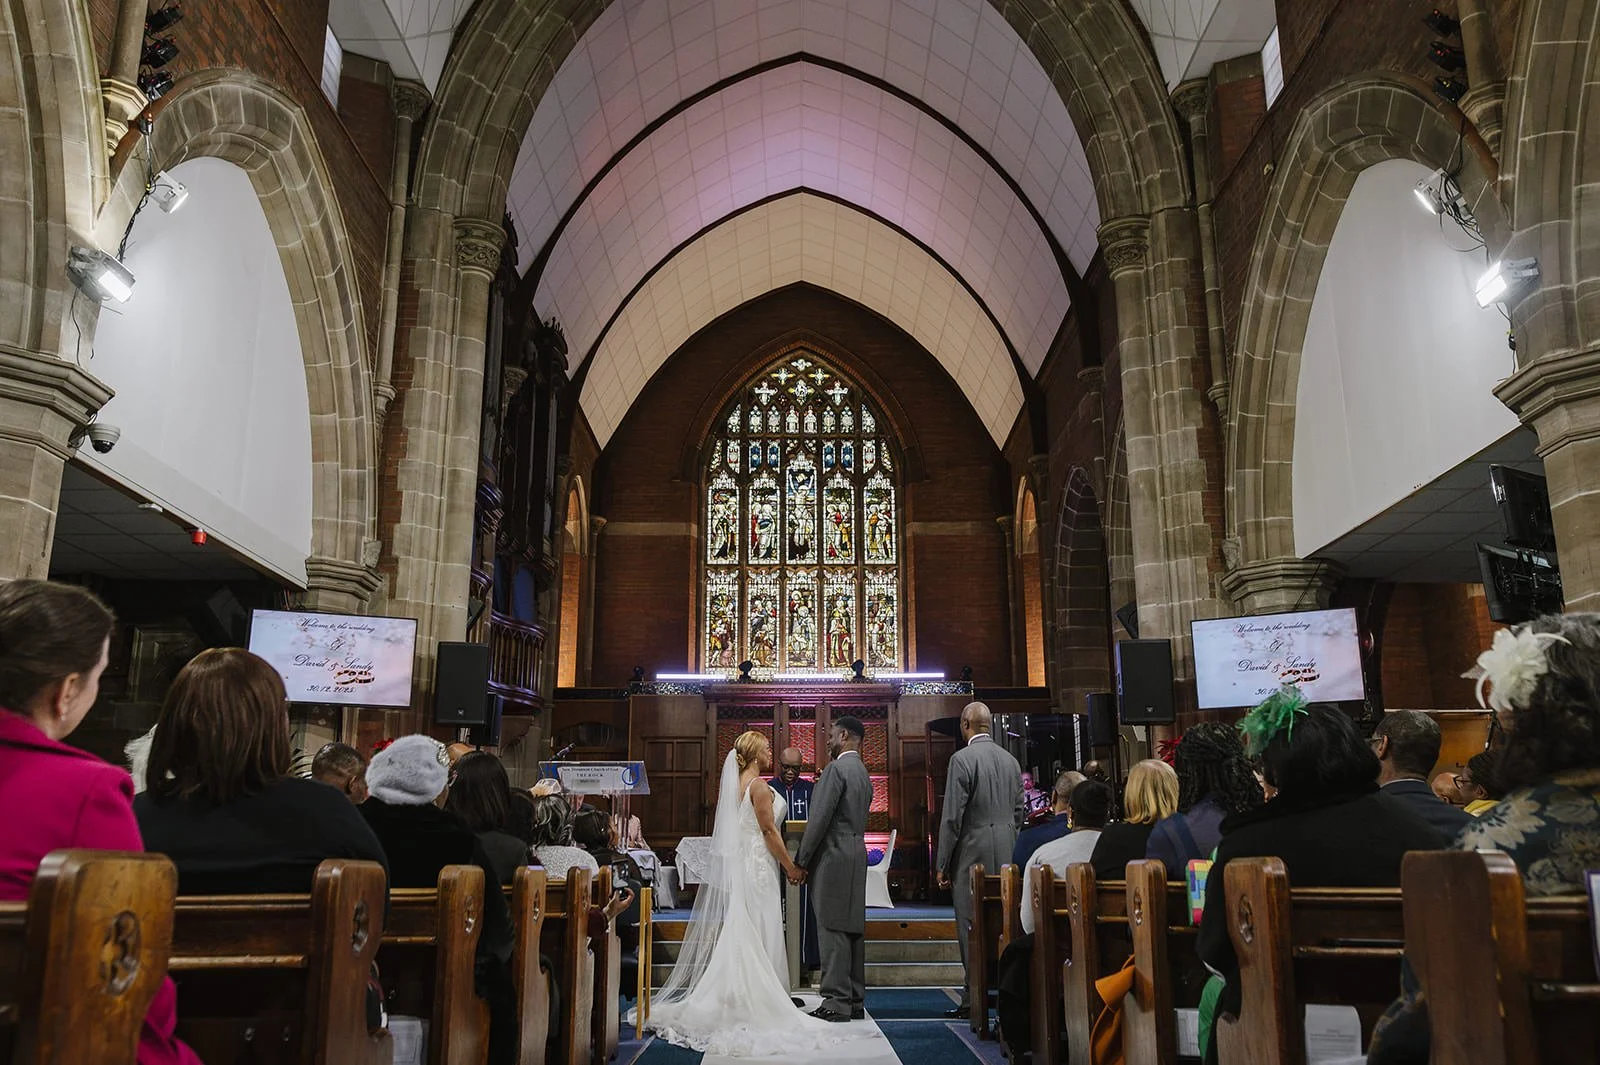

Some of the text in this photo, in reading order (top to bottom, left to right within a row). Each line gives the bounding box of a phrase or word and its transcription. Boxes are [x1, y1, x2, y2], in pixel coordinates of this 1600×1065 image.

[300, 617, 328, 629] Welcome
[337, 622, 347, 630] the
[348, 623, 375, 633] wedding
[1236, 623, 1263, 633] Welcome
[1272, 622, 1282, 630] the
[1283, 620, 1311, 631] wedding
[293, 653, 330, 667] David
[341, 656, 374, 671] Sandy
[1238, 659, 1272, 672] David
[1283, 655, 1316, 669] Sandy
